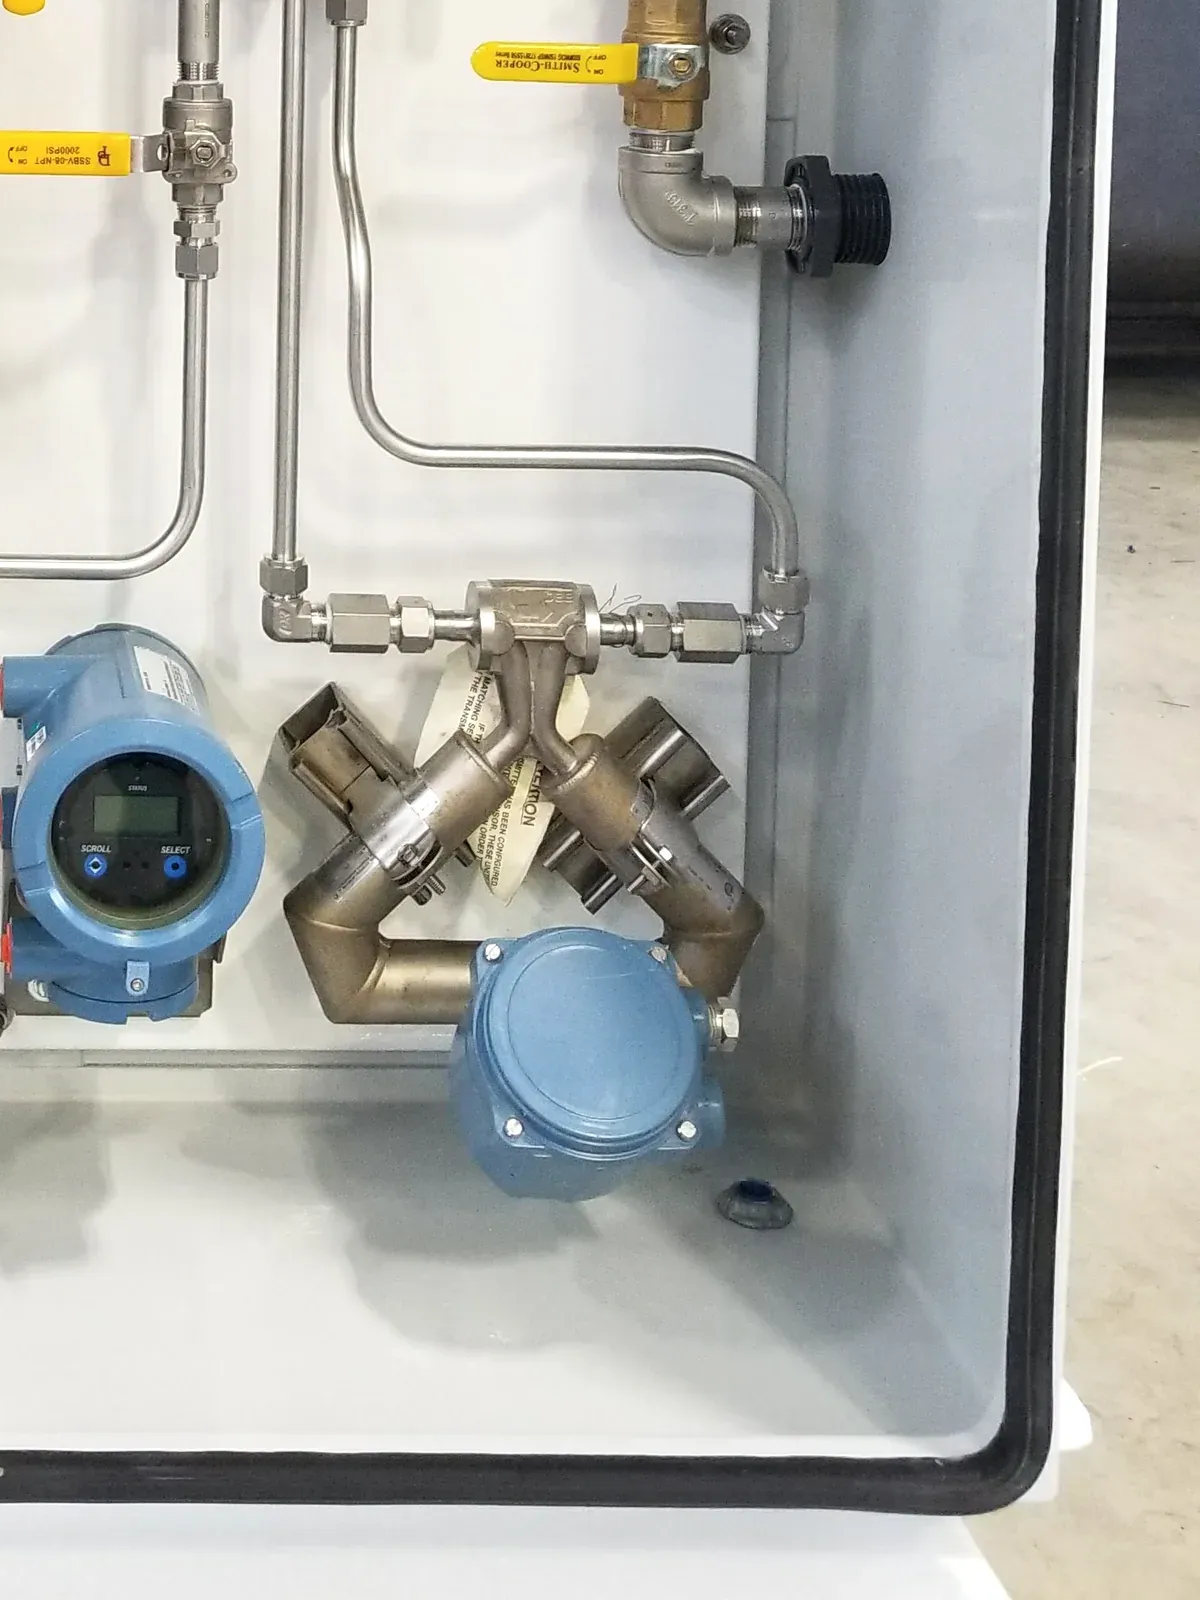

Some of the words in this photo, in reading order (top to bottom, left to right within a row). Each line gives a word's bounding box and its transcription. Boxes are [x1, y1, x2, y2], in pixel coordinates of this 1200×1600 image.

[495, 59, 581, 74] SMITH-COOPER
[34, 157, 91, 165] SSBV-08-NPT
[470, 676, 481, 693] THE
[471, 676, 492, 721] MATCHING
[478, 722, 486, 732] IF
[499, 811, 510, 836] BEEN
[81, 844, 111, 853] SCROLL
[161, 846, 191, 854] SELECT
[476, 825, 488, 854] ORDER
[484, 833, 496, 860] THESE
[491, 836, 506, 888] CONFIGURED
